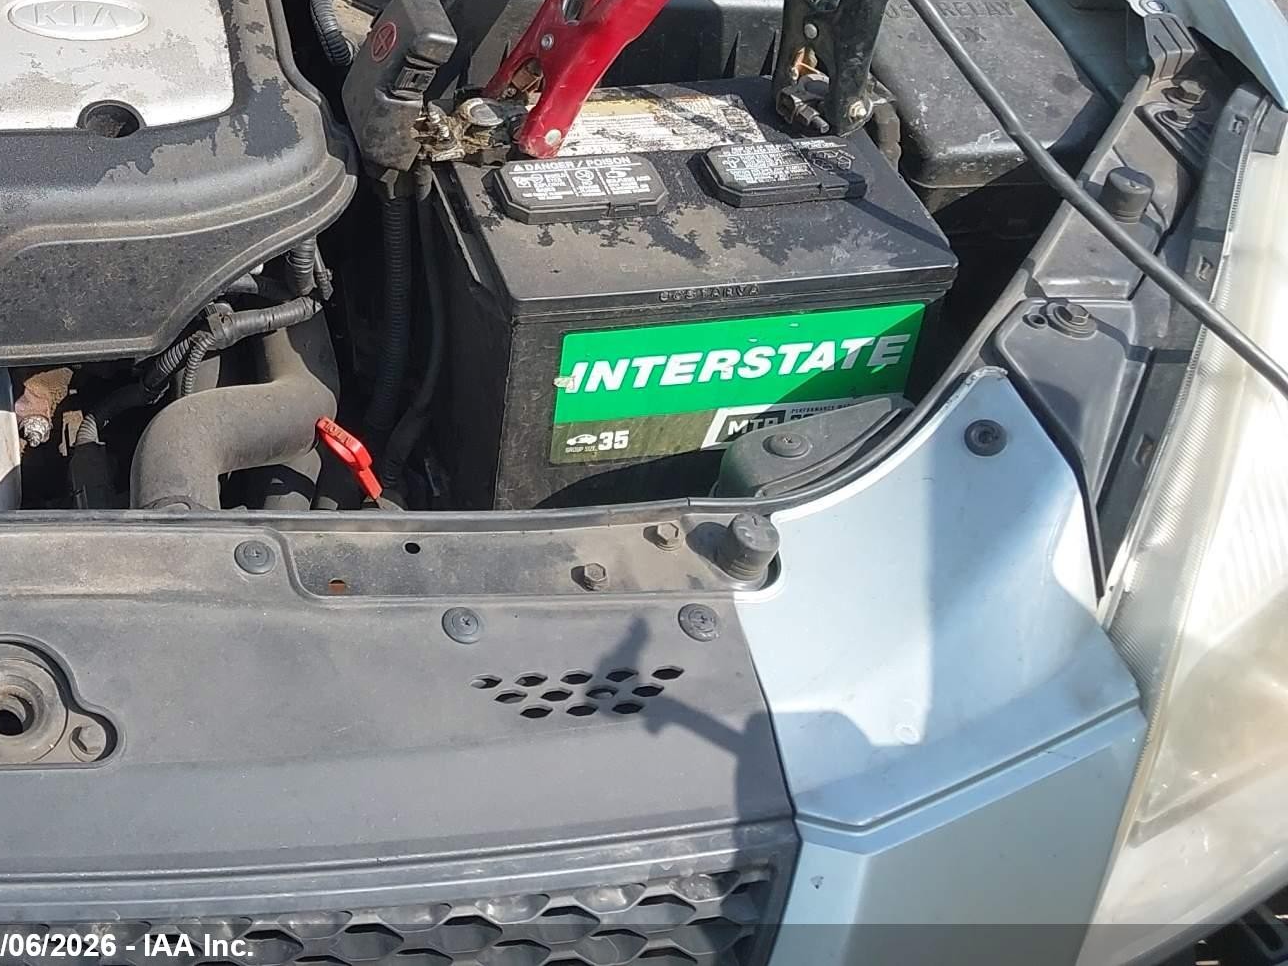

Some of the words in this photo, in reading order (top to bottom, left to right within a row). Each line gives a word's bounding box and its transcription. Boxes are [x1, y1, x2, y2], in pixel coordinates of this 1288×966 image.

[32, 2, 120, 27] KIA
[937, 0, 1016, 18] RELAY
[523, 161, 575, 172] DANGER
[584, 156, 632, 167] POISON
[564, 333, 912, 395] INTERSTATE
[565, 445, 584, 453] GROUP
[598, 430, 630, 451] 35
